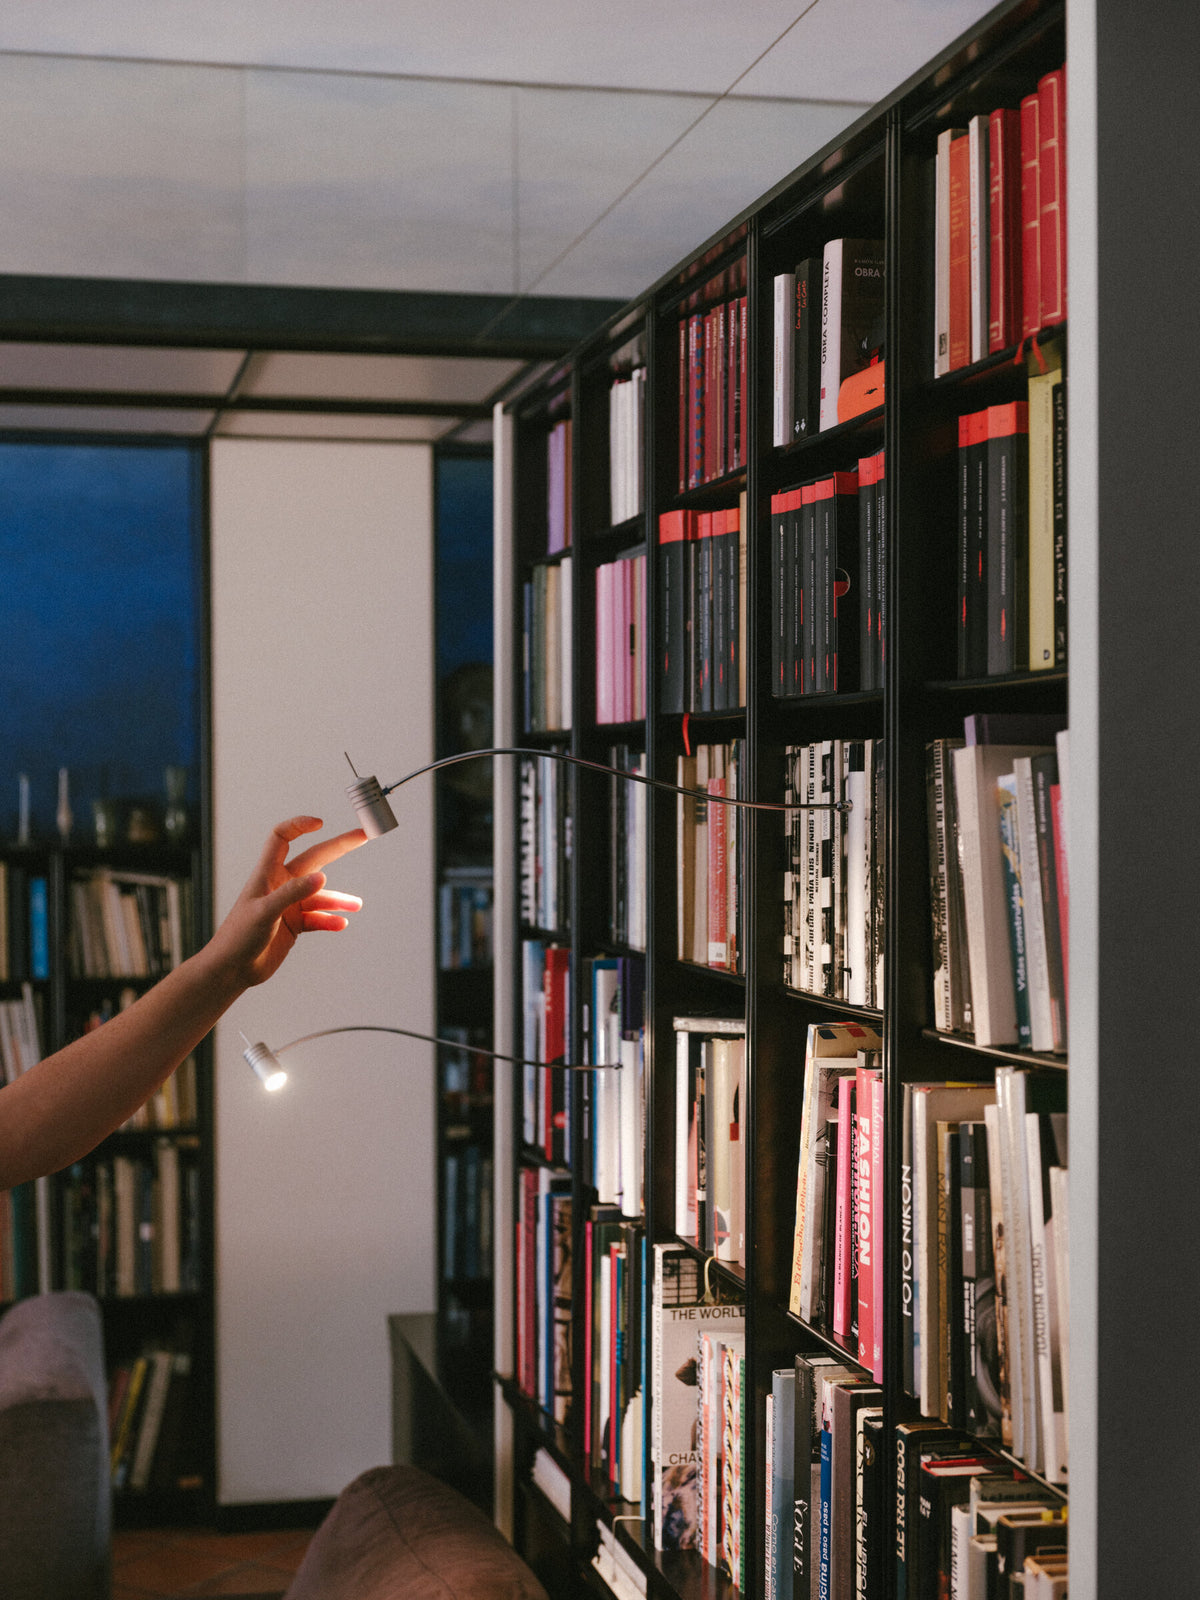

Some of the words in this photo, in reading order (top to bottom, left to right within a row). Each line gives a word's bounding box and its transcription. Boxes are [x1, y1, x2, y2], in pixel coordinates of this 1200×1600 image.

[822, 261, 830, 327] COMPLETA
[854, 267, 881, 278] OBRA
[1010, 882, 1024, 954] construidas
[1016, 954, 1026, 992] Vidas
[872, 1096, 884, 1165] Marilyn
[859, 1115, 871, 1267] FASHION
[901, 1163, 912, 1245] NIKON
[937, 1172, 947, 1224] MAN
[801, 1216, 806, 1224] a
[795, 1225, 805, 1273] derecho
[937, 1231, 947, 1273] RAY
[1031, 1243, 1045, 1290] GOMIS
[793, 1272, 802, 1287] El
[901, 1249, 912, 1318] FOTO
[670, 1308, 697, 1321] THE
[699, 1306, 746, 1319] WORLD
[896, 1438, 905, 1491] 1900
[771, 1512, 779, 1554] Como
[822, 1501, 830, 1526] paso
[822, 1526, 829, 1535] a
[793, 1499, 809, 1576] VOGUE
[896, 1528, 906, 1563] LE
[951, 1525, 959, 1582] HELMUT
[771, 1556, 777, 1572] en
